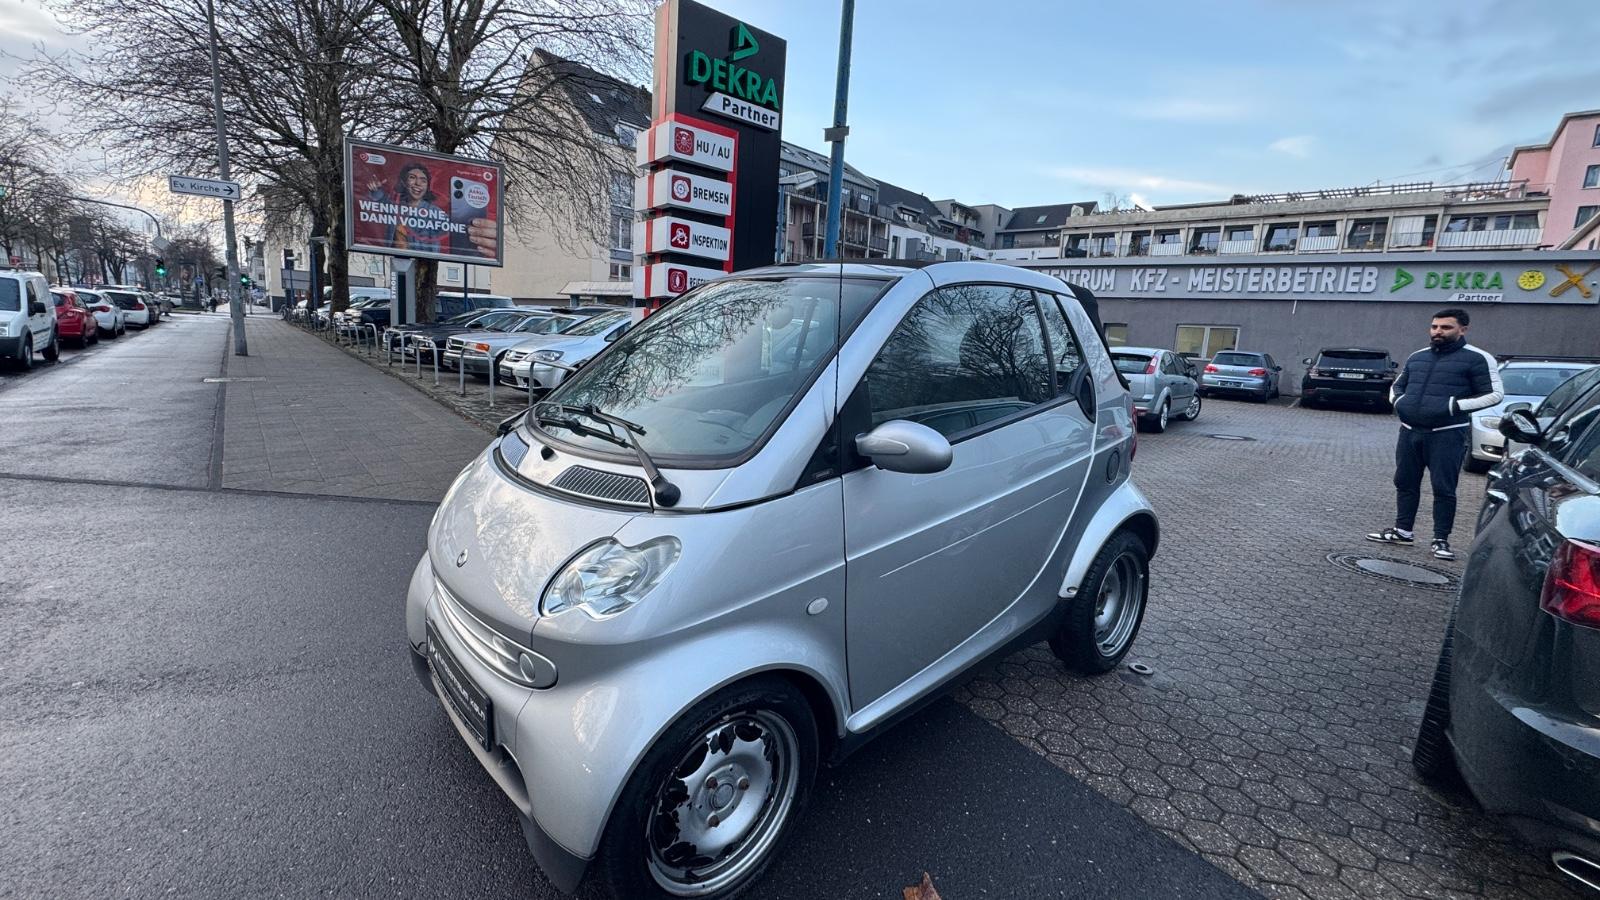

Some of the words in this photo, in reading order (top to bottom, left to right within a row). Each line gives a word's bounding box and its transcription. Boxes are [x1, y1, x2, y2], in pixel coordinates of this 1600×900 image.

[687, 49, 779, 109] DEKRA
[722, 96, 776, 129] Partner
[696, 140, 710, 154] HU
[717, 144, 730, 159] AU
[190, 182, 220, 192] Kirche
[693, 186, 729, 205] BREMSEN
[359, 200, 398, 214] WENN
[360, 212, 397, 225] DANN
[400, 216, 466, 234] VODAFONE
[692, 233, 728, 251] INSPEKTION
[1041, 268, 1116, 291] NTRUM
[1187, 266, 1378, 293] MEISTERBETRIEB
[1424, 271, 1503, 290] DEKRA
[1457, 293, 1500, 302] Partner
